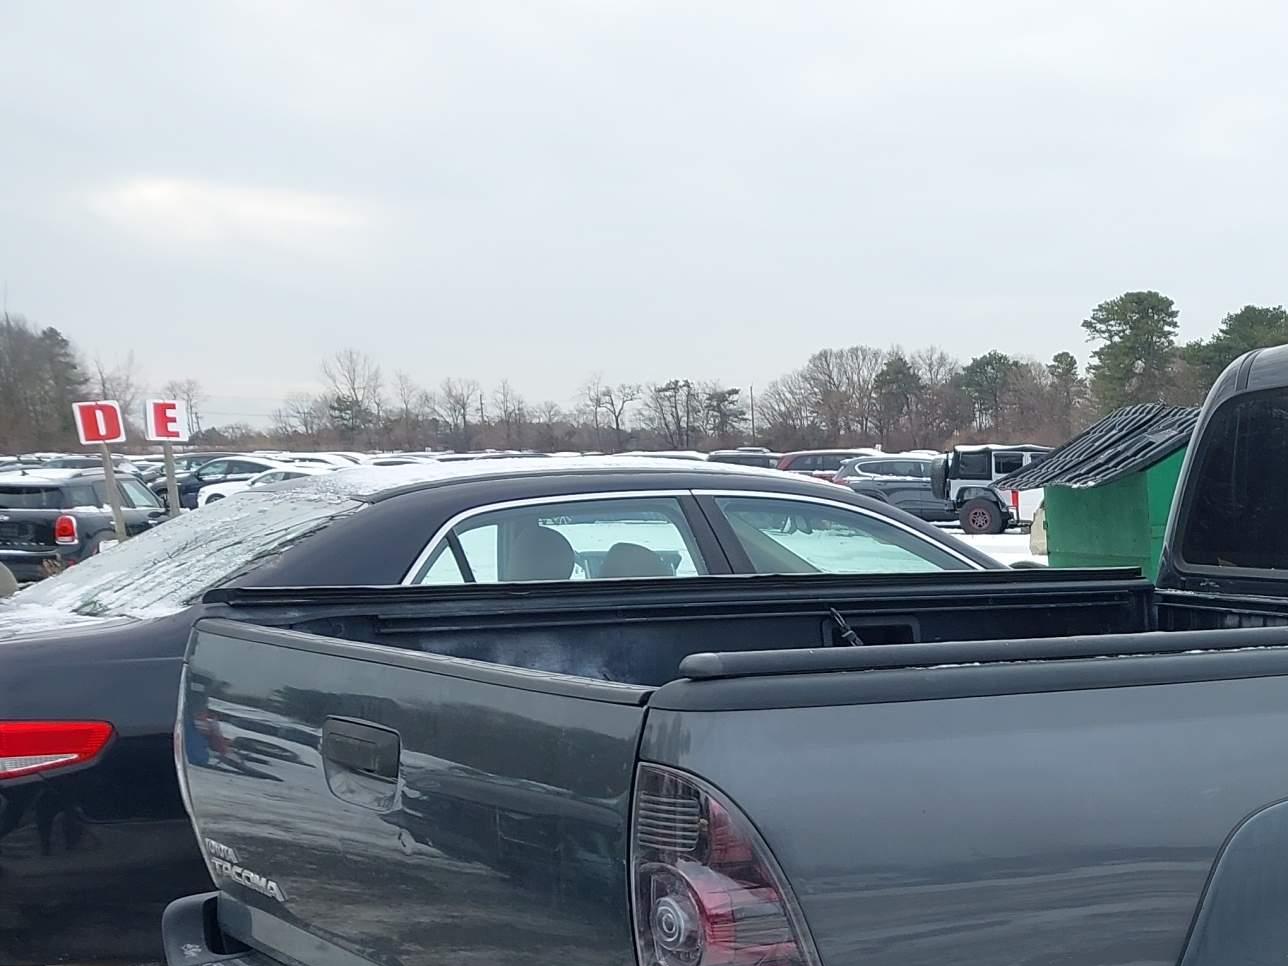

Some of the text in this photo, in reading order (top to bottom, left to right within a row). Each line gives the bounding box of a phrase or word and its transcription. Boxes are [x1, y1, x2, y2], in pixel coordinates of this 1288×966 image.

[78, 403, 121, 442] D
[152, 402, 180, 438] E
[210, 856, 286, 902] TACOMA
